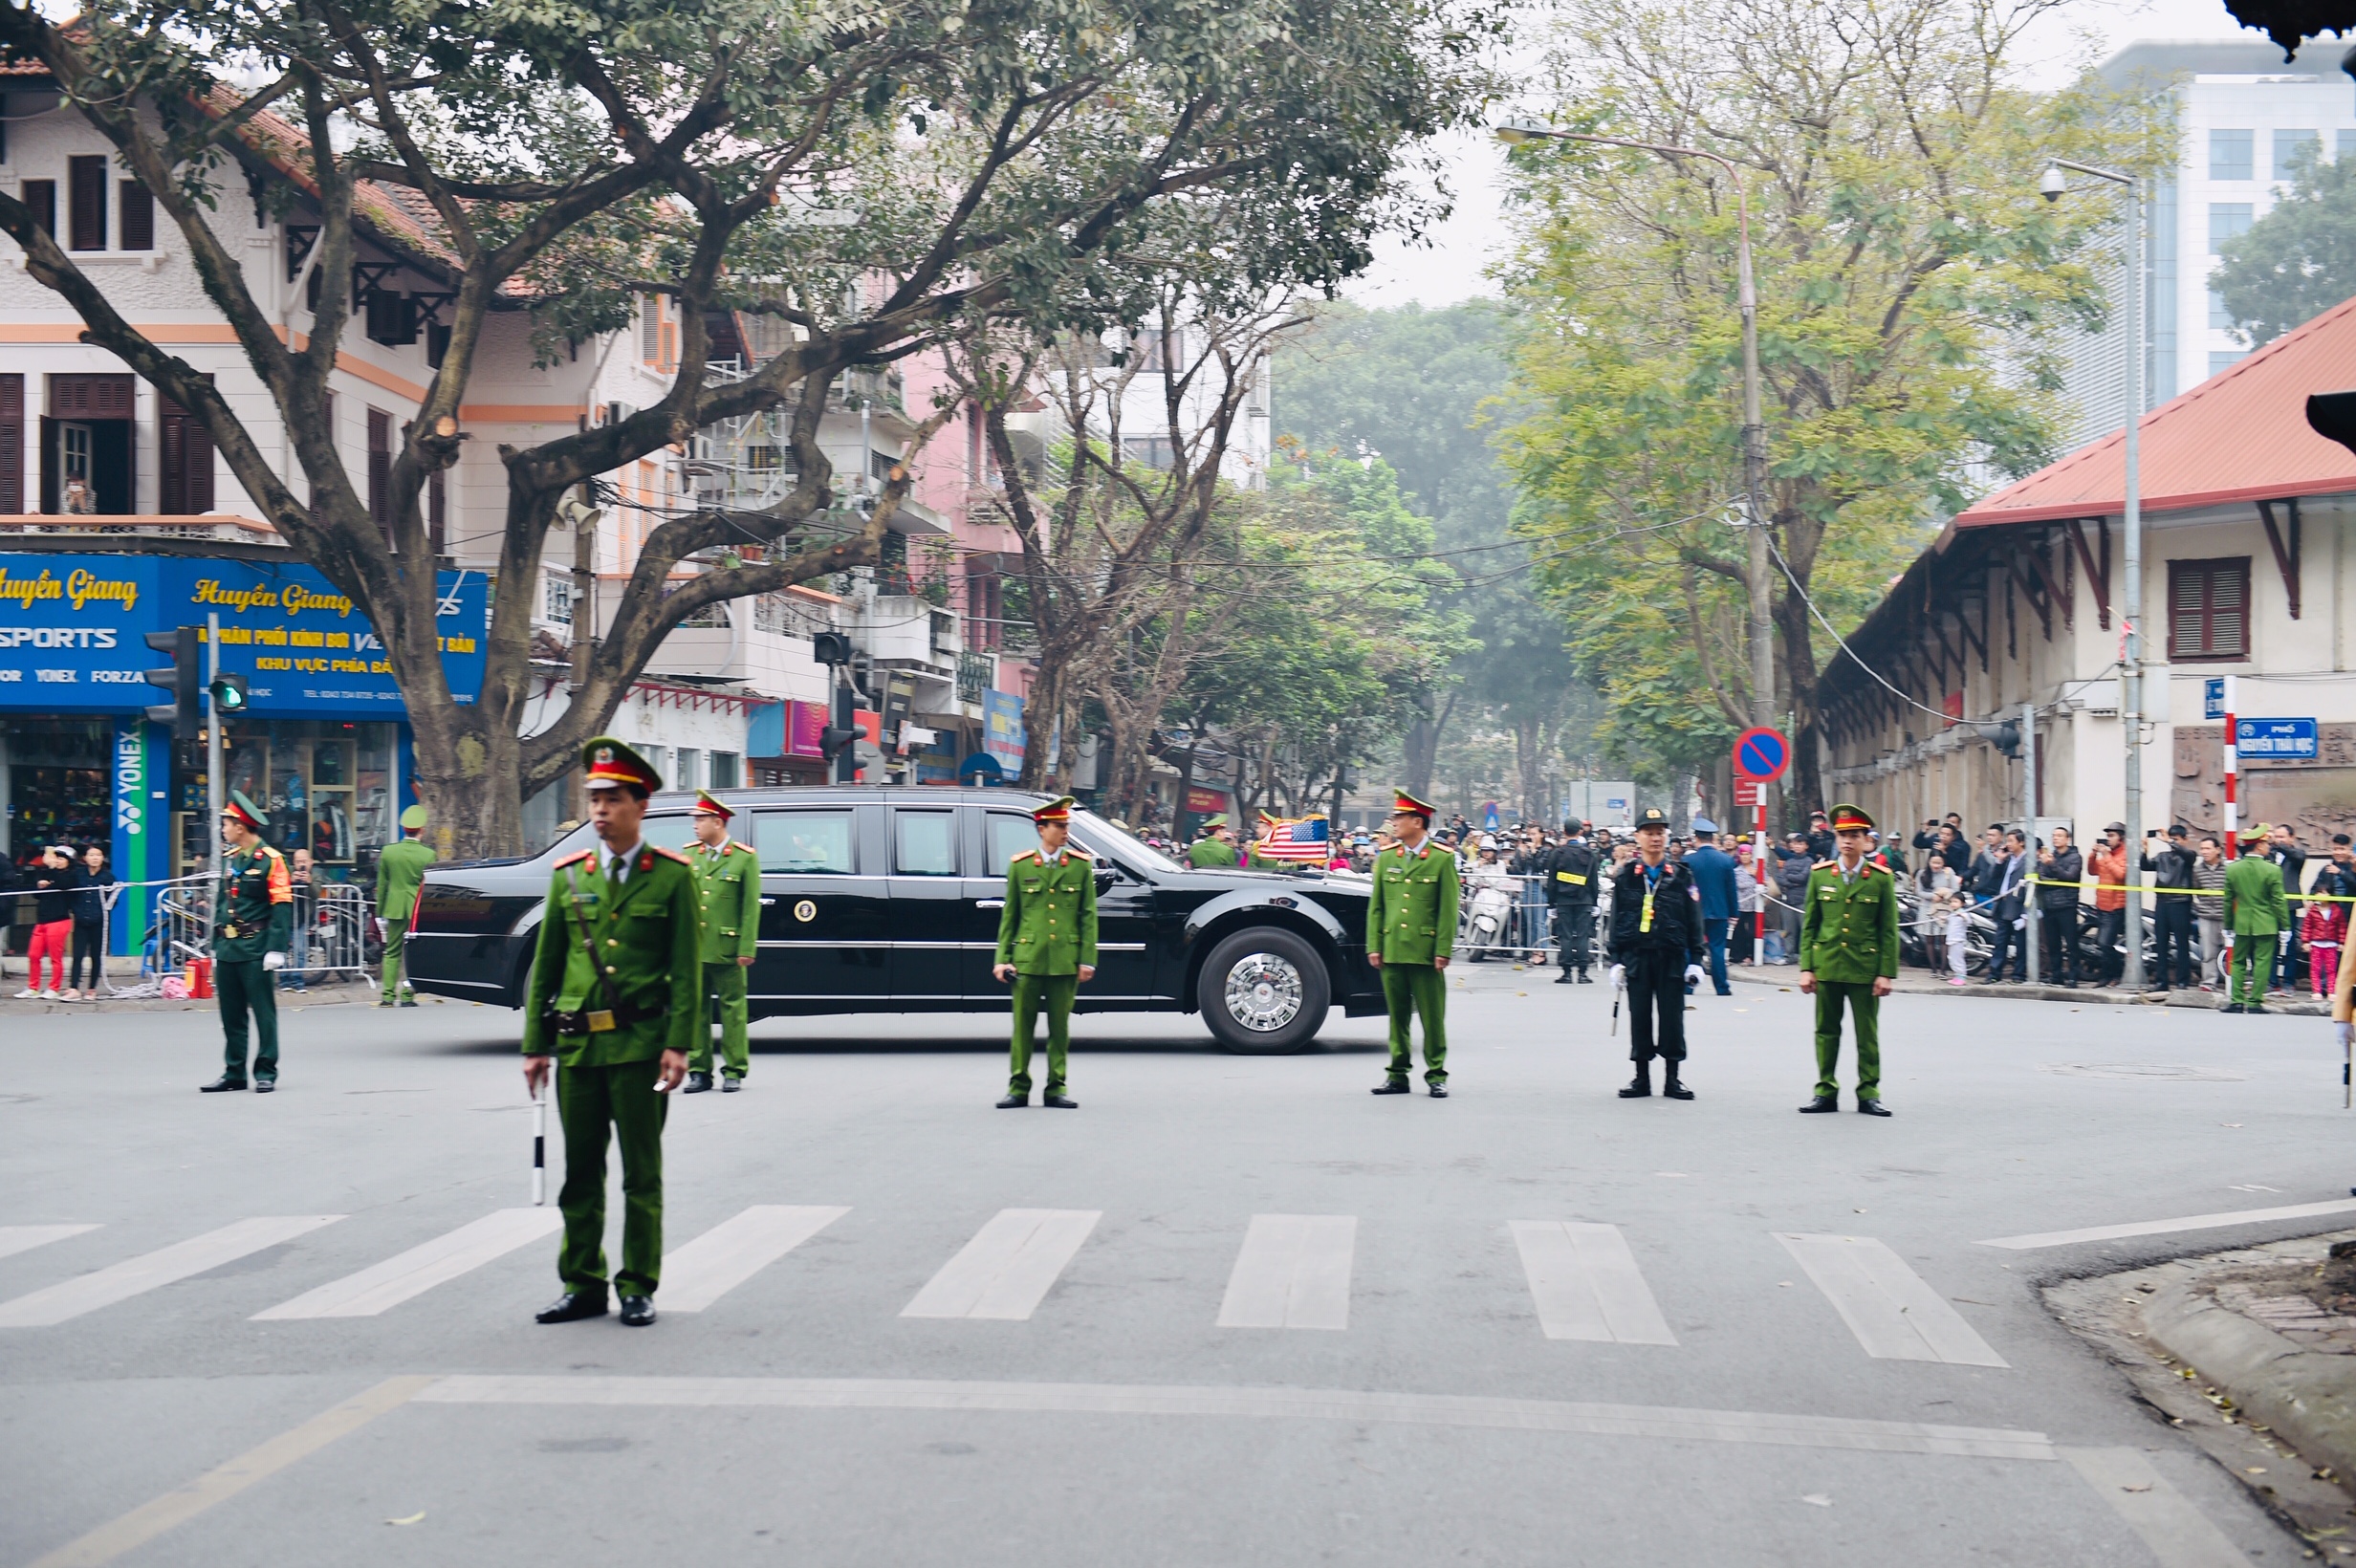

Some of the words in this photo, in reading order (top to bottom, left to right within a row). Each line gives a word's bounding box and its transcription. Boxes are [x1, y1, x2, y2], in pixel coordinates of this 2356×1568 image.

[67, 568, 140, 611] Giang
[190, 578, 278, 613] Huyền
[281, 584, 354, 618] Giang
[0, 627, 118, 648] SPORTS
[255, 657, 292, 670] KHU
[294, 657, 329, 674] VỰC
[331, 657, 369, 673] PHÍA
[370, 655, 395, 673] BẮ
[34, 669, 78, 683] YONEX
[91, 670, 145, 684] FORZA
[2271, 724, 2296, 733] PHỐ
[2237, 734, 2274, 751] NGUYỄN
[118, 731, 142, 794] YONEX
